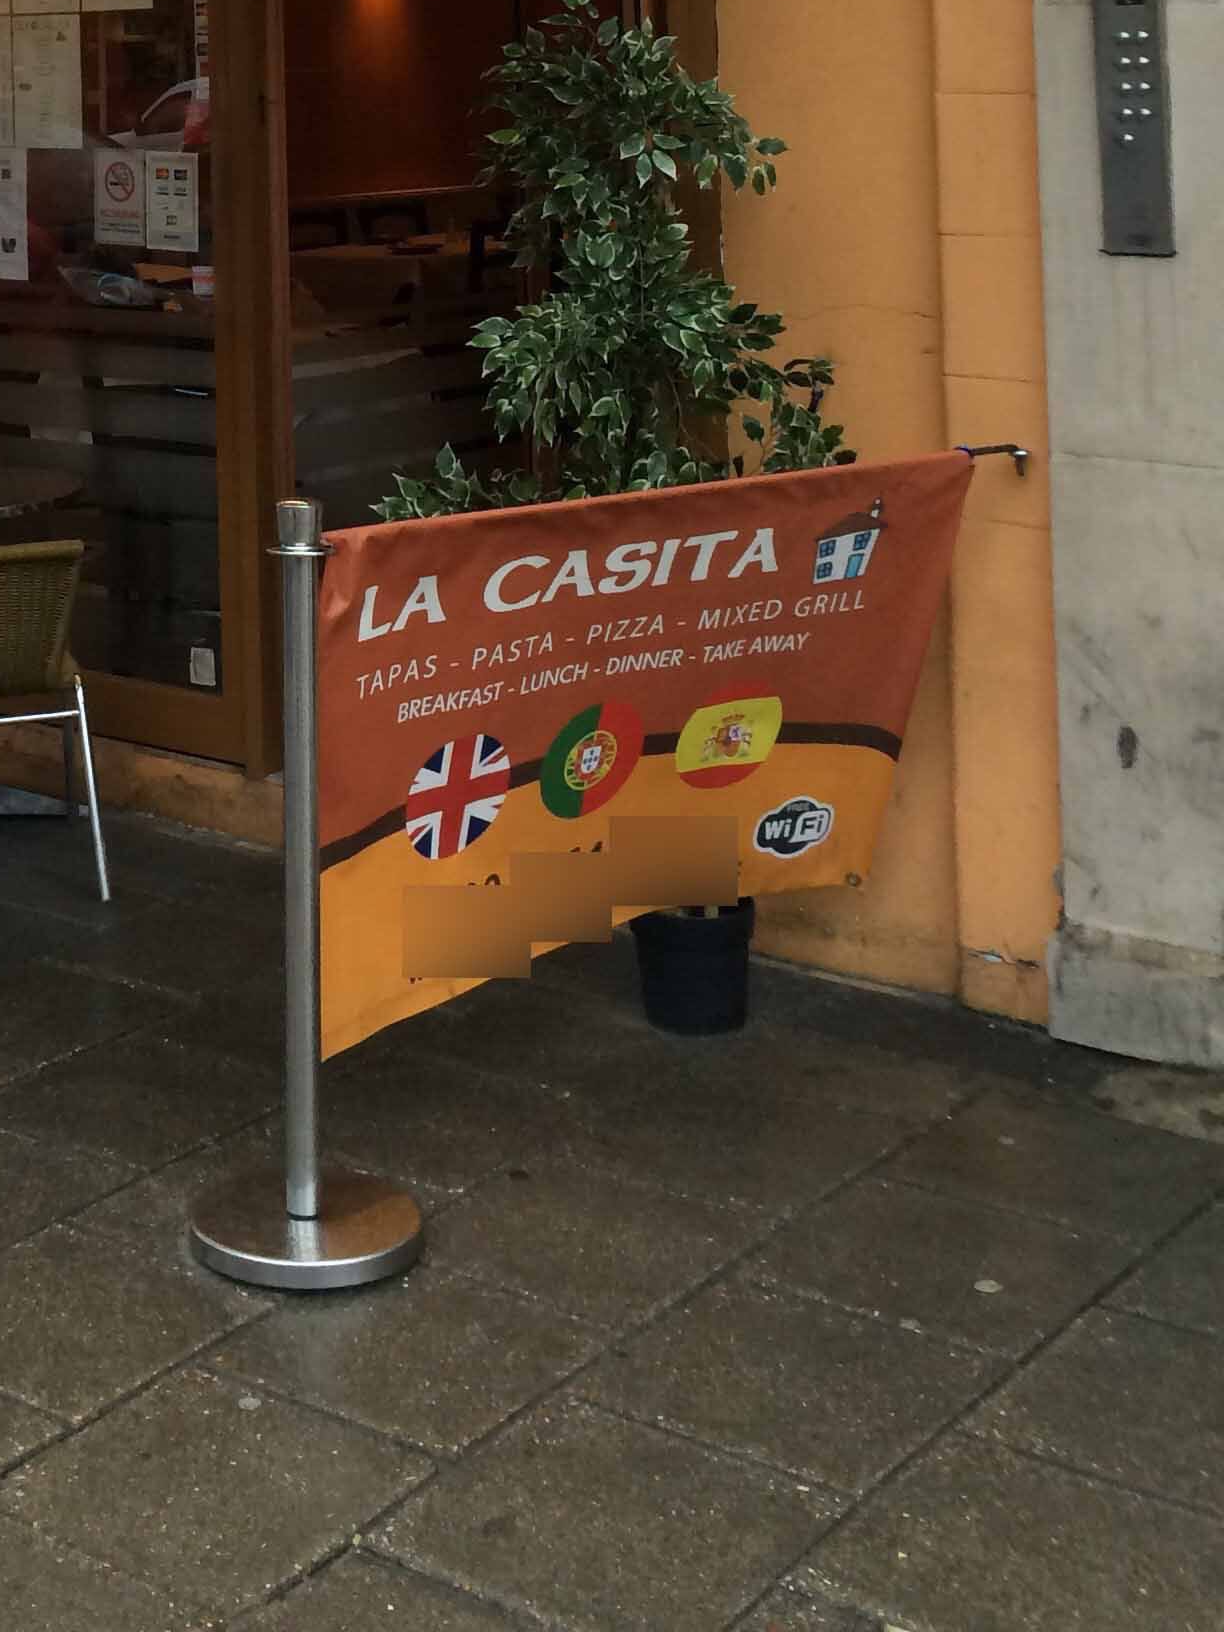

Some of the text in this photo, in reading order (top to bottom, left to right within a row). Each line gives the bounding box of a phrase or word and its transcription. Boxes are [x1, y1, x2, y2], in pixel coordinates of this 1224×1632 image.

[357, 527, 778, 642] LA CASITA
[356, 589, 865, 699] TAPAS PASTA PIZZA MIXED GRILL
[397, 631, 812, 724] BREAKFAST LUNCH DINNER TAKE AWAY
